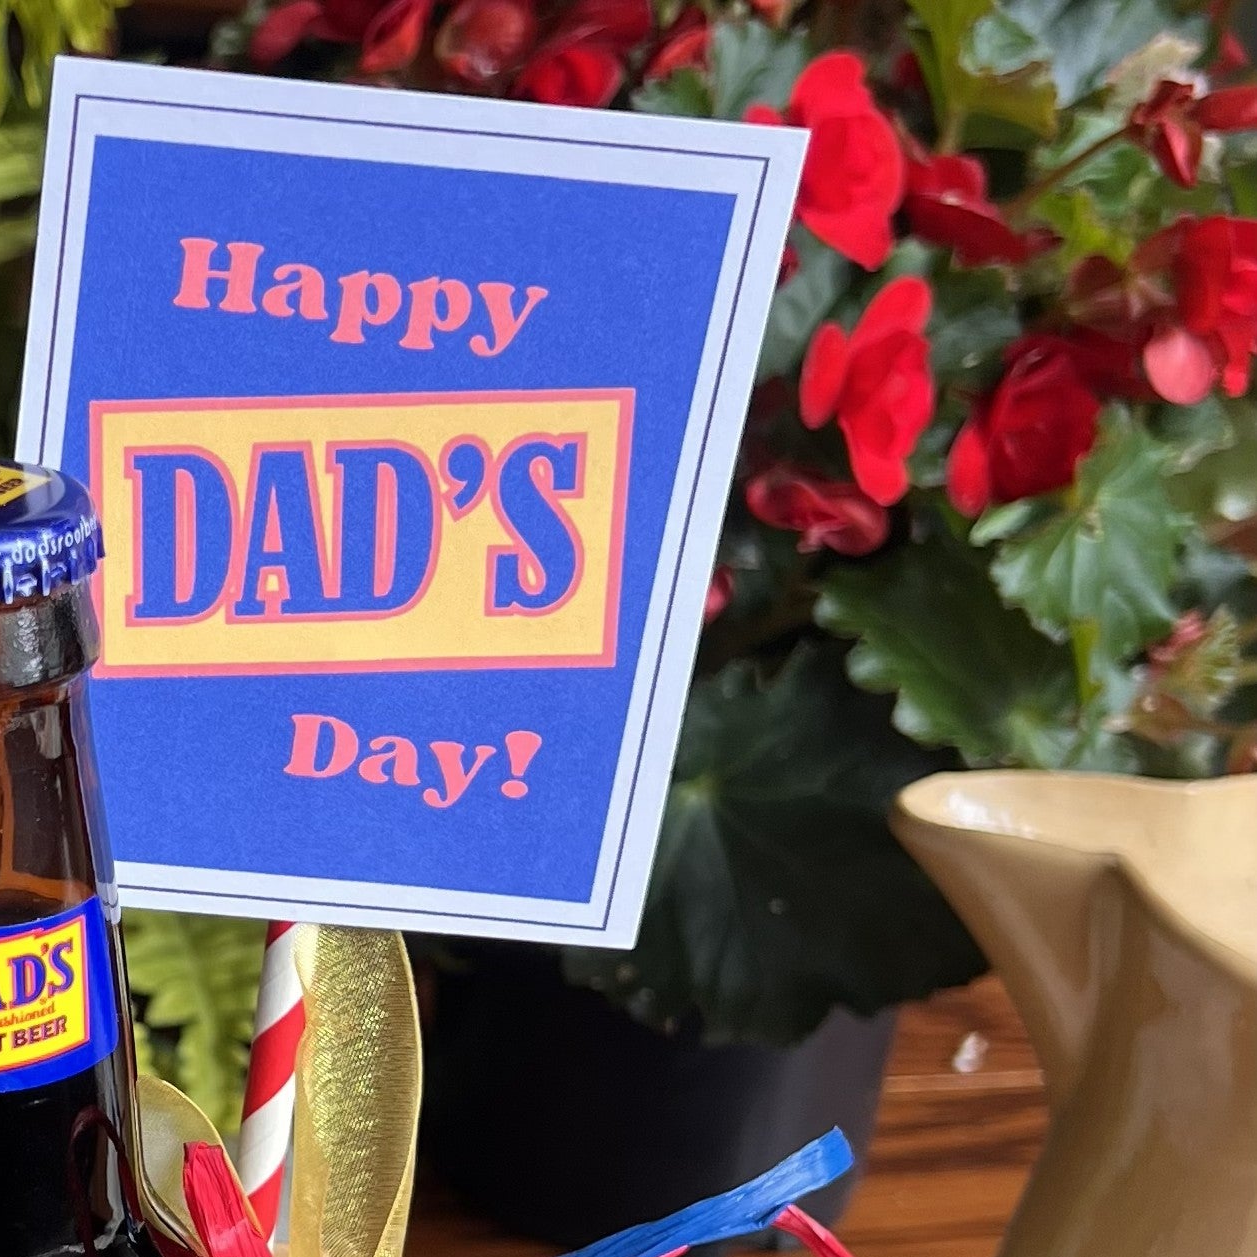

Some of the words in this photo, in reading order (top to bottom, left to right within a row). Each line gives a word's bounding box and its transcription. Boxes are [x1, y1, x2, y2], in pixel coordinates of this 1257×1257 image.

[173, 238, 548, 356] Happy
[124, 432, 587, 628] DAD'S
[284, 714, 542, 808] Day!
[11, 1015, 68, 1049] BEER
